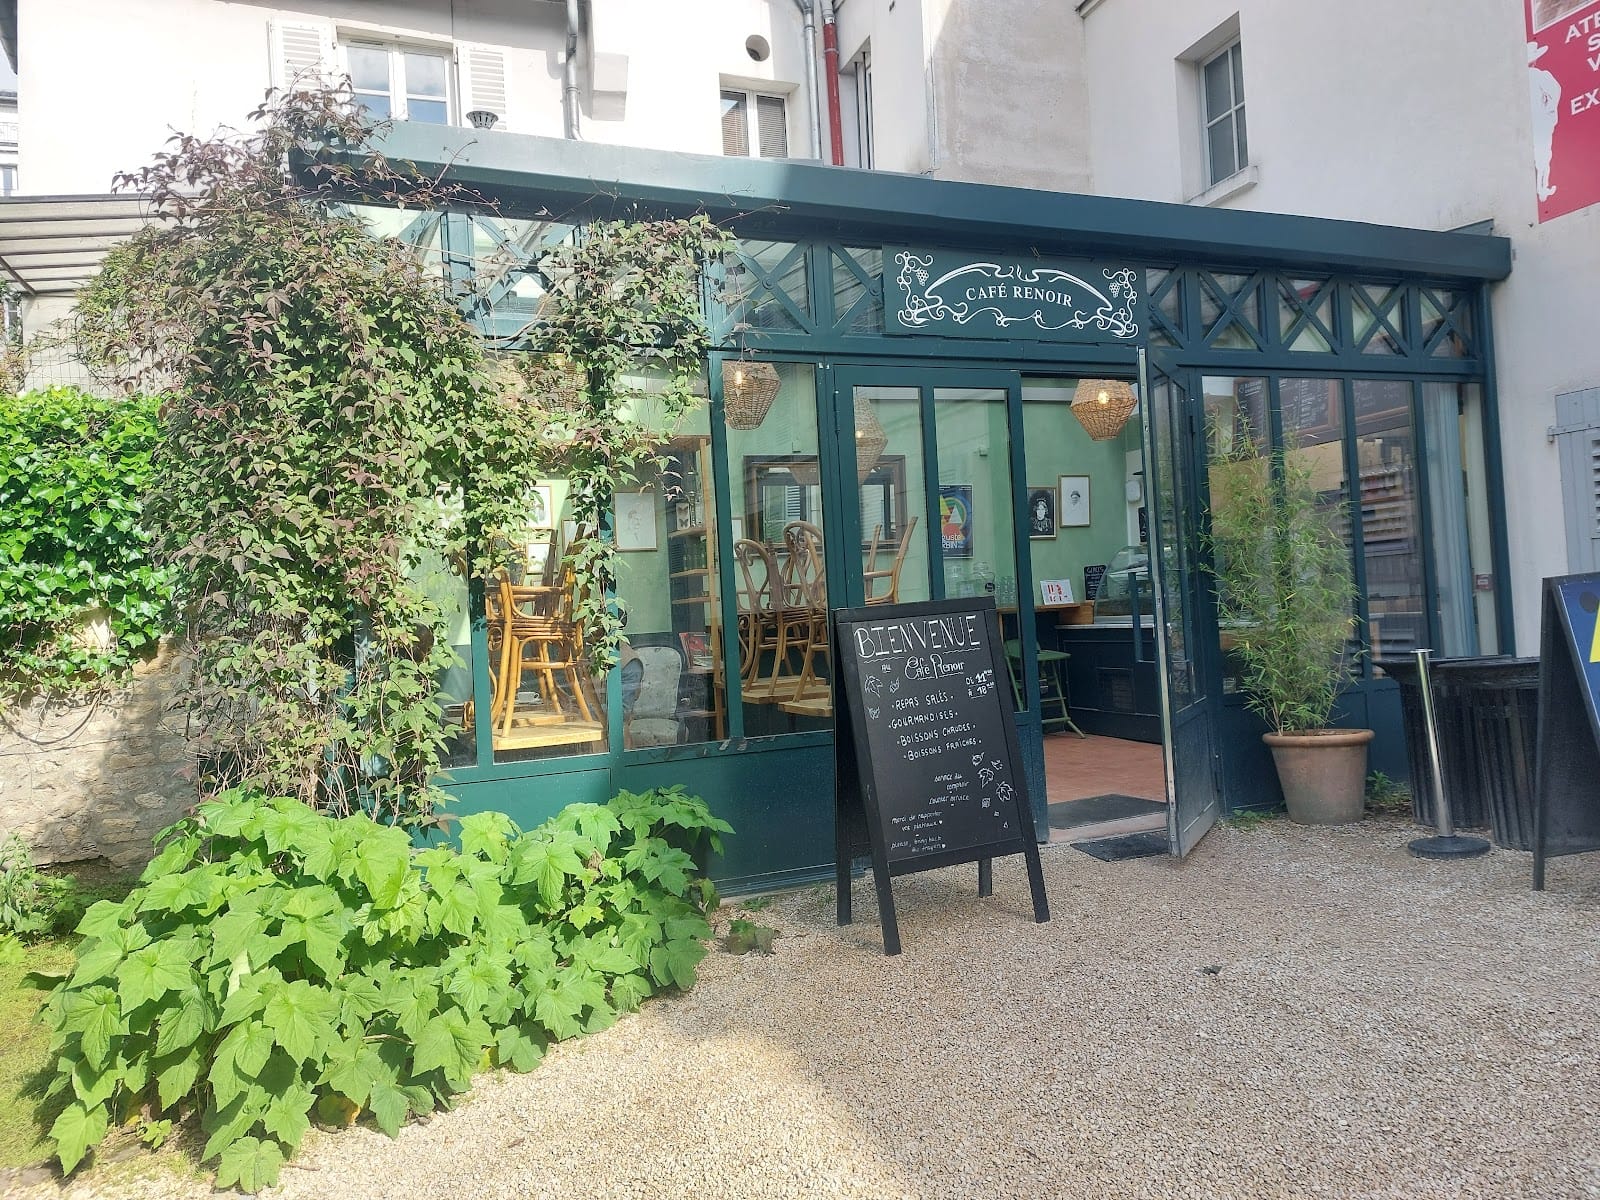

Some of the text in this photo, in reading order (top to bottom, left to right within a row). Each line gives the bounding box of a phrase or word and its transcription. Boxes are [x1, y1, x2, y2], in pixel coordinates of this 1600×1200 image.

[966, 283, 1072, 307] CAFÉ RENOIR
[853, 615, 981, 658] BIENVENUE
[930, 654, 965, 679] Renoir
[895, 696, 919, 710] REPAS
[891, 709, 954, 729] GOURMANDISES
